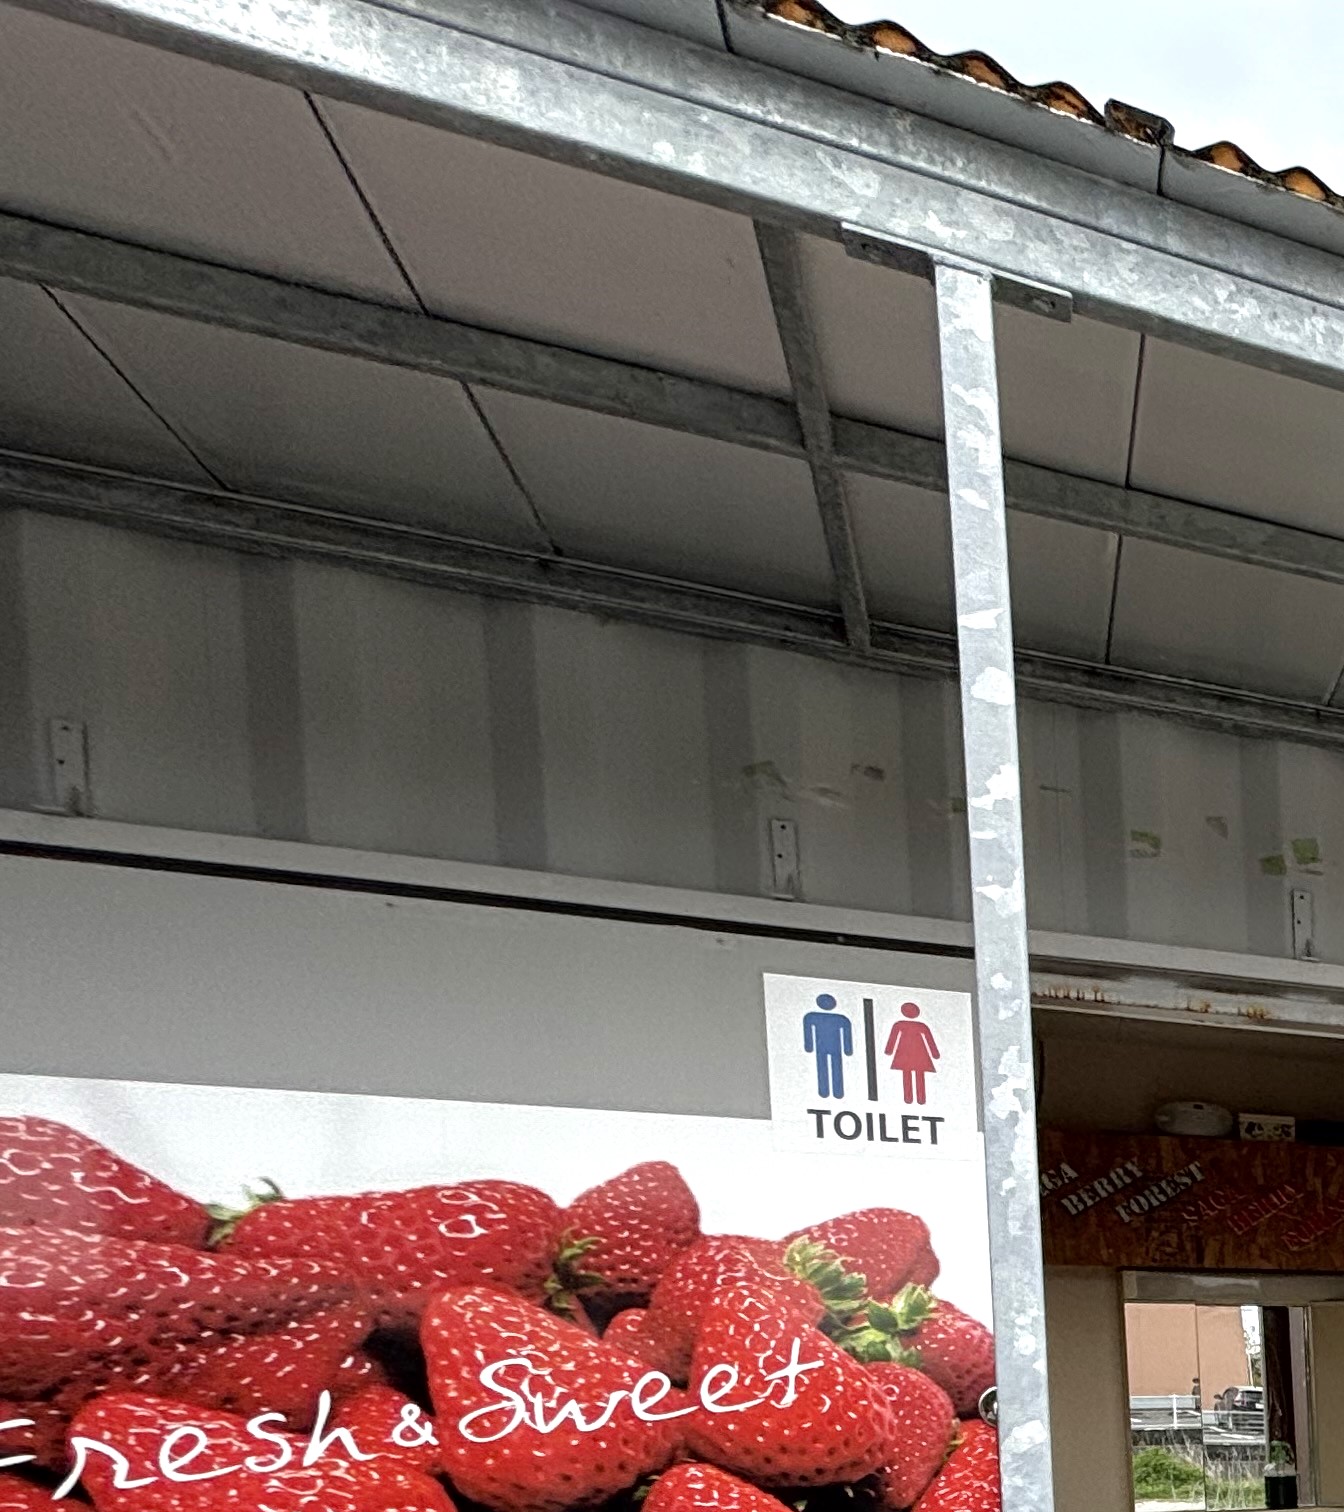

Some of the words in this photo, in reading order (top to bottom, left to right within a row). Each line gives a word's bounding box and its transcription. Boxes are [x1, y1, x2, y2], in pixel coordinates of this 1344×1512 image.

[806, 1106, 946, 1146] TOILET
[1060, 1157, 1143, 1216] BERRY
[1115, 1161, 1206, 1223] FOREST
[392, 1402, 440, 1448] &
[456, 1338, 824, 1443] Sweet
